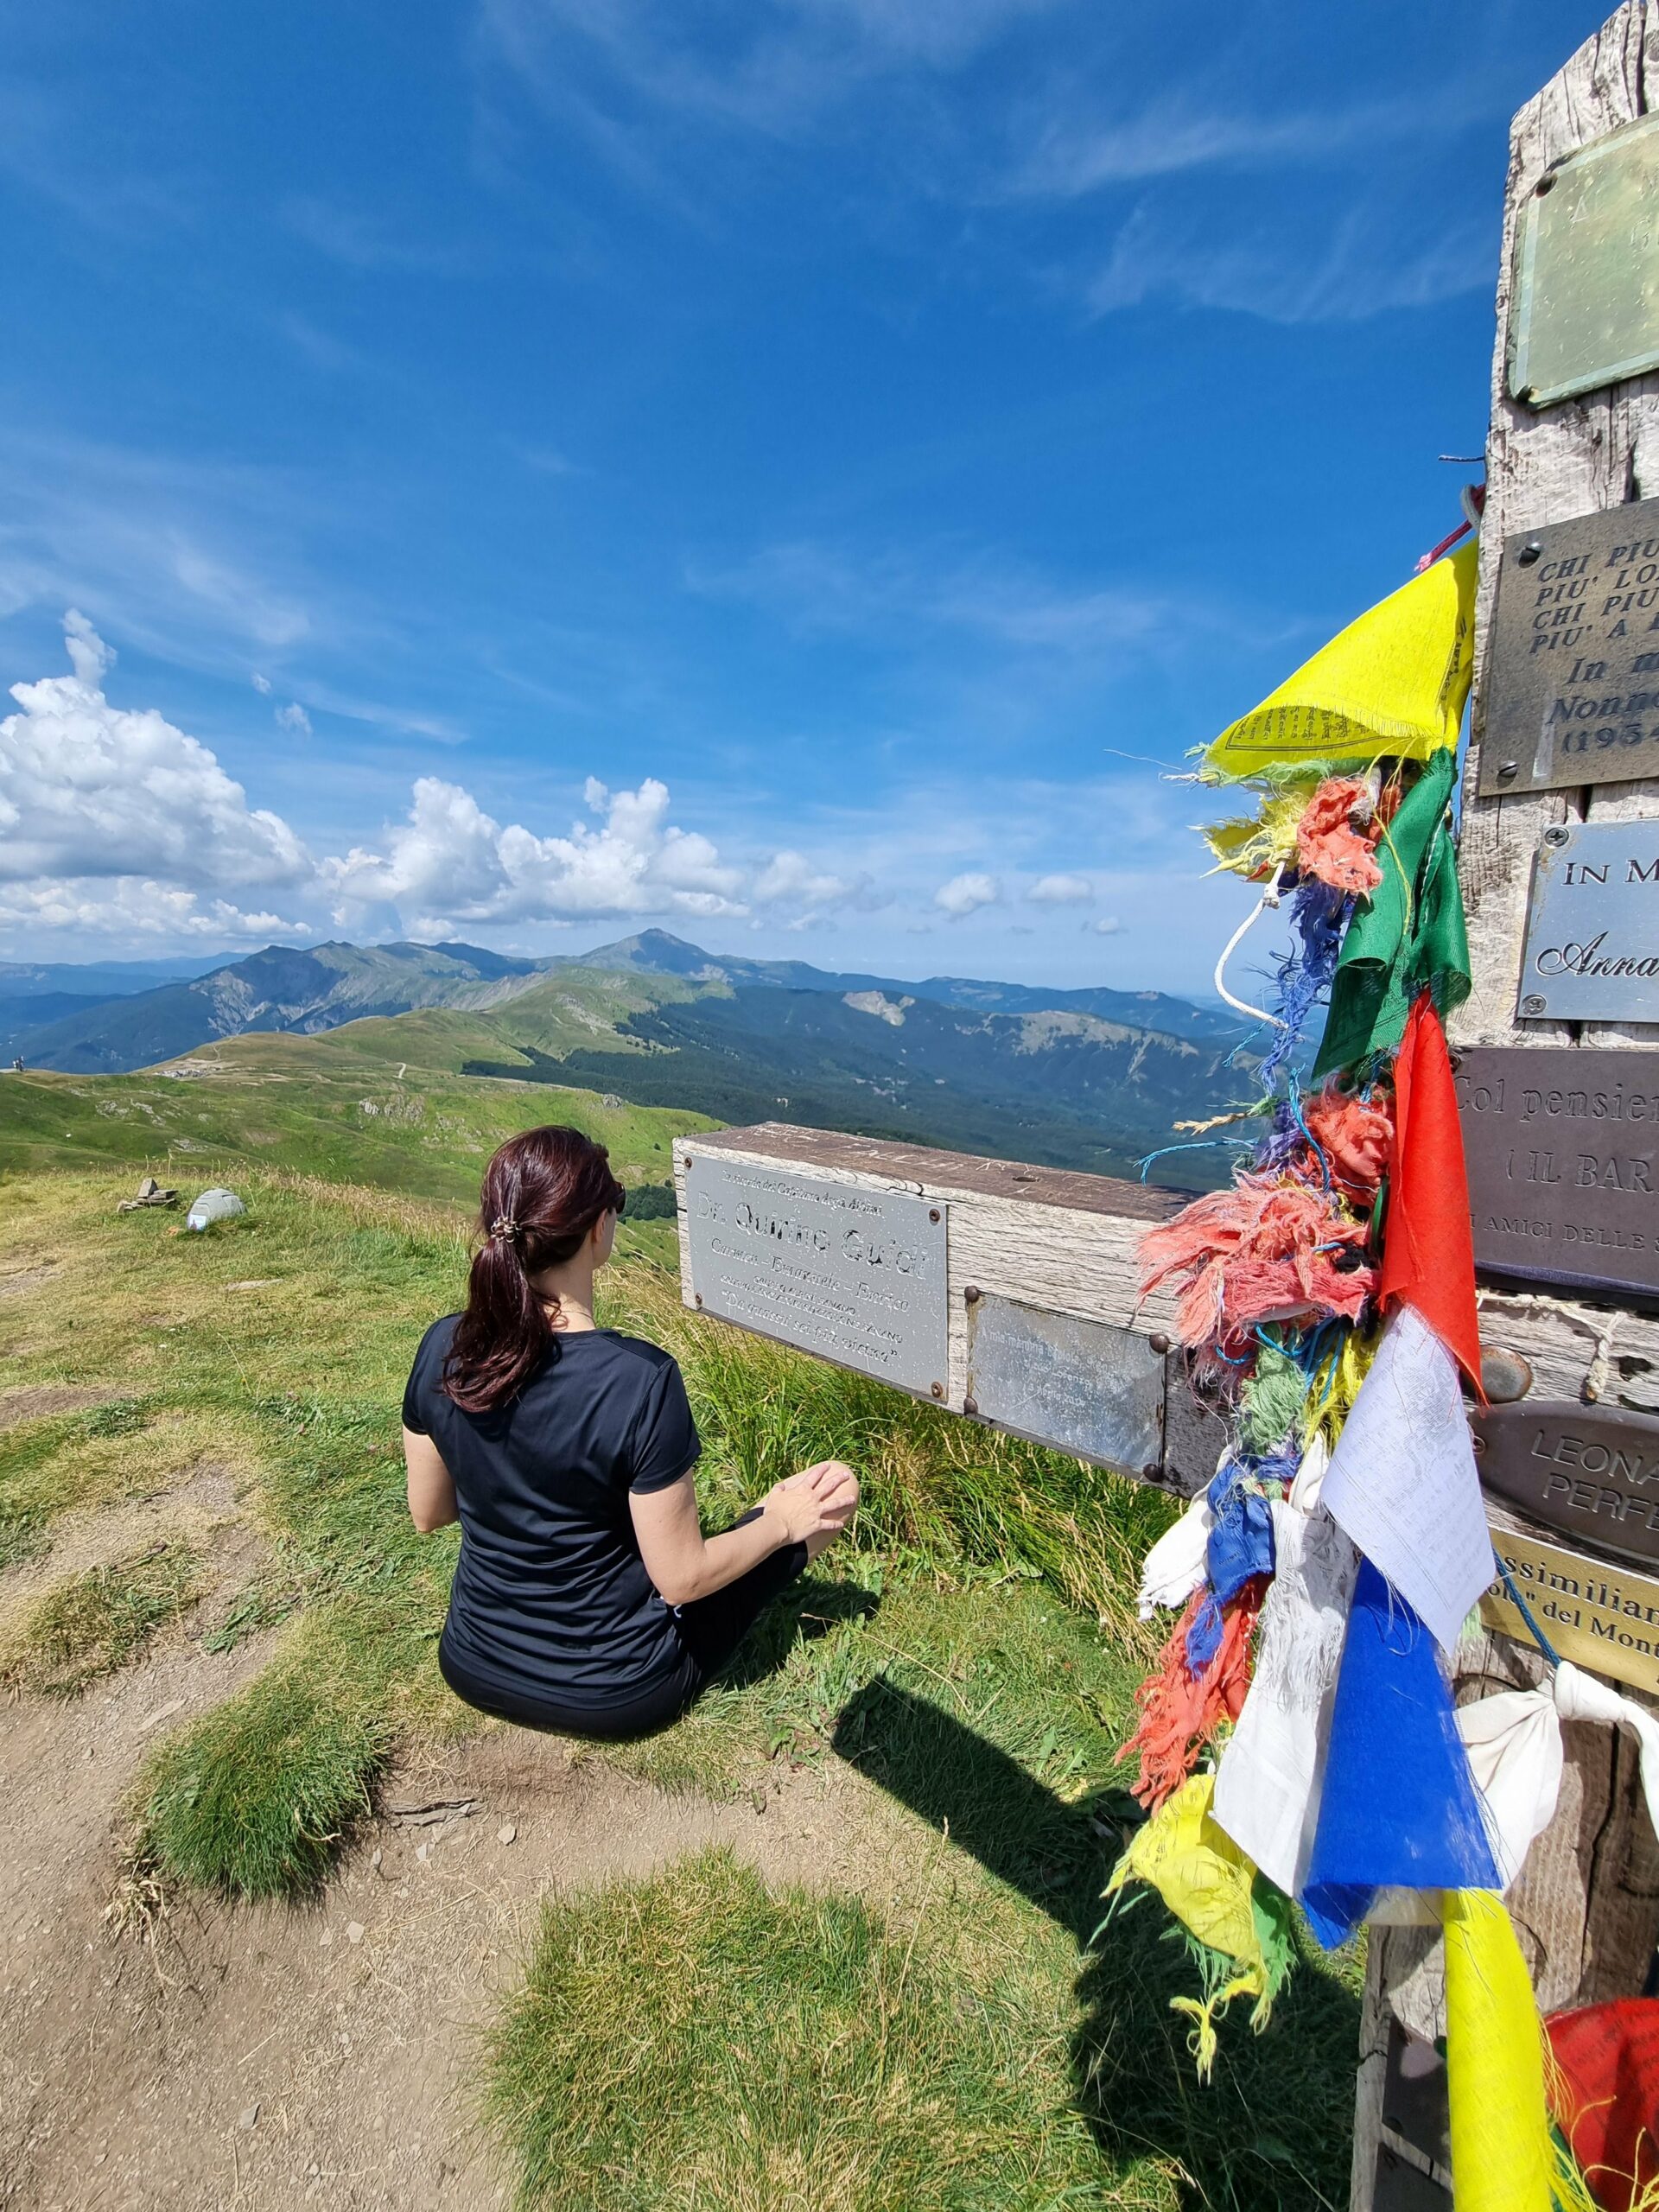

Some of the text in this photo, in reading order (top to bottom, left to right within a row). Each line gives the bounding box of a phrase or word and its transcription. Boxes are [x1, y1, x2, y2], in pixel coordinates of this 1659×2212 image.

[1535, 563, 1659, 607] PIU' LO
[1538, 554, 1591, 584] CHI
[1533, 602, 1586, 631] CHI
[1529, 625, 1592, 654] PIU'
[1606, 619, 1629, 639] A
[1565, 658, 1606, 685] In
[1561, 862, 1611, 886] IN
[1535, 931, 1659, 976] Anna
[1455, 1077, 1506, 1115] Col
[1527, 1151, 1562, 1185] IL
[1574, 1154, 1659, 1194] BAR
[778, 1182, 820, 1201] Capitano
[735, 1202, 831, 1253] Quirino
[842, 1229, 928, 1281] Guidi
[1484, 1216, 1554, 1239] AMICI
[1562, 1224, 1645, 1251] DELLE
[712, 1238, 759, 1267] Carmen
[771, 1255, 840, 1291] Emanuele
[1530, 1429, 1659, 1485] LEONA
[1542, 1601, 1580, 1629] del
